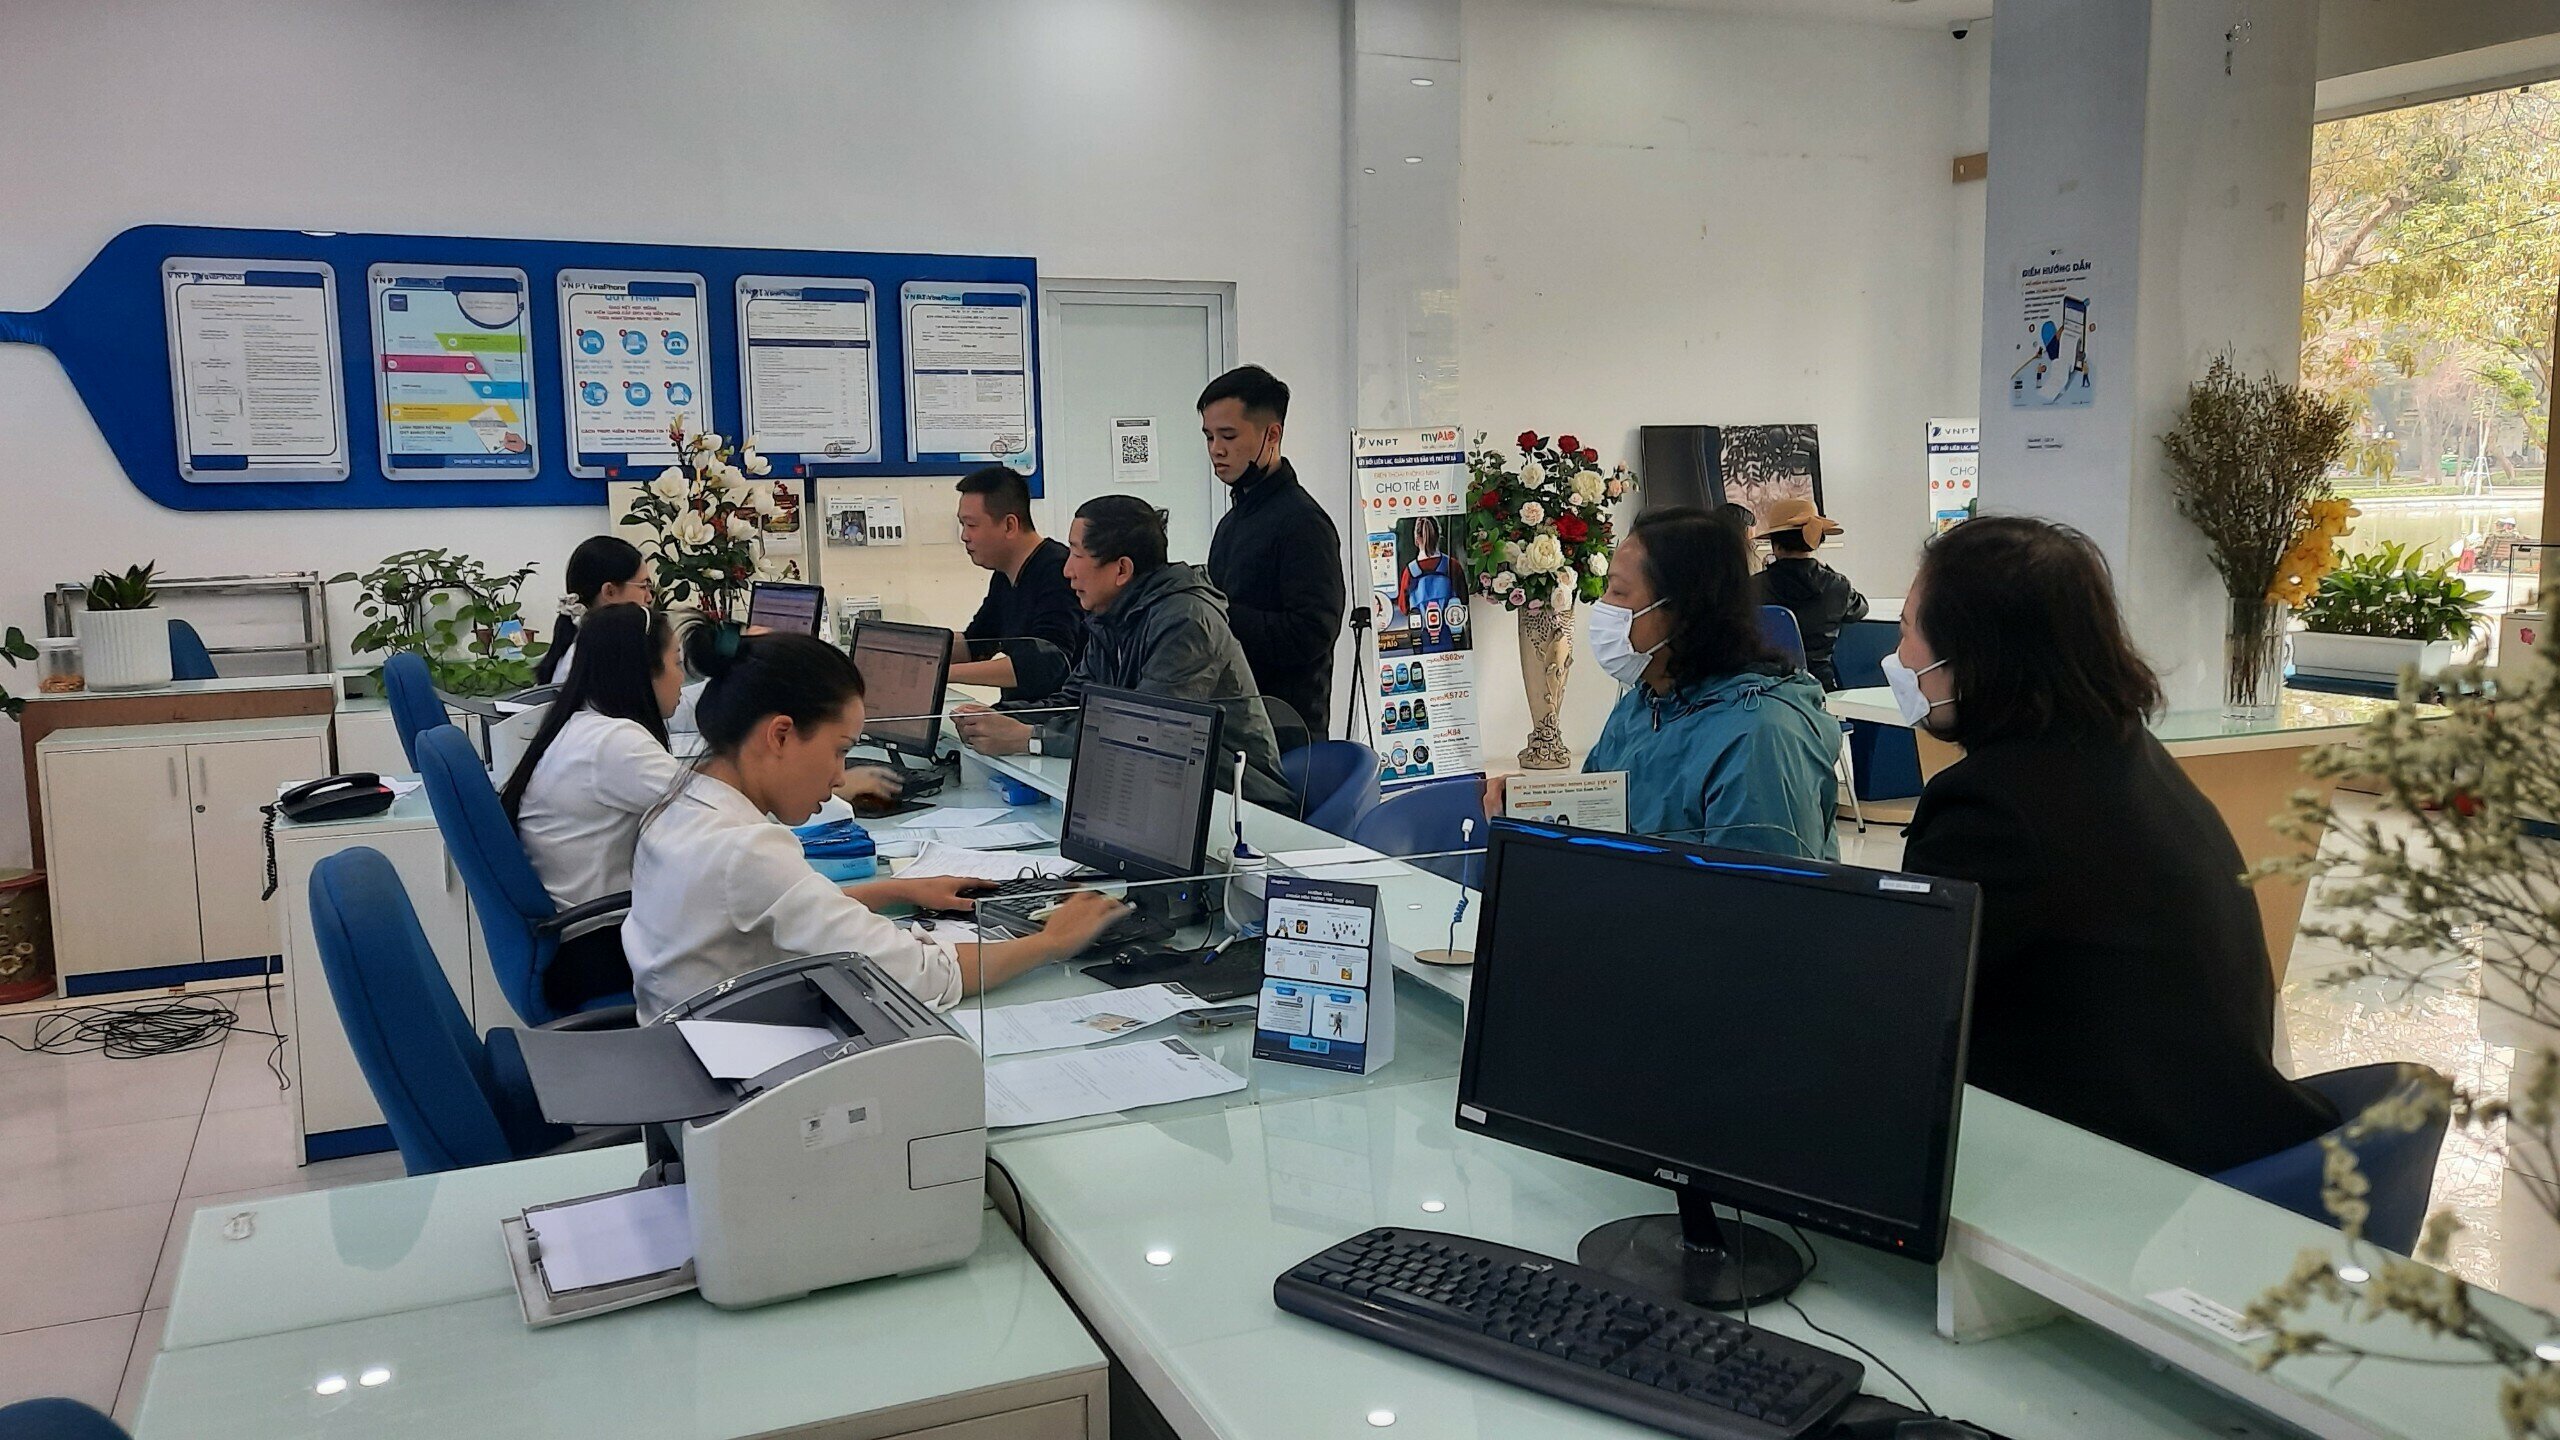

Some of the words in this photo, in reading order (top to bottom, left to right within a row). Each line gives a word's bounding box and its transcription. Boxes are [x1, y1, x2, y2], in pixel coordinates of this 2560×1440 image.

[561, 282, 585, 290] VNPT
[1369, 439, 1398, 447] VNPT
[1950, 466, 1977, 476] CHO
[1376, 482, 1402, 493] CHO
[1404, 478, 1421, 492] TRẺ
[1424, 480, 1440, 490] EM
[1654, 1167, 1689, 1185] ASUS
